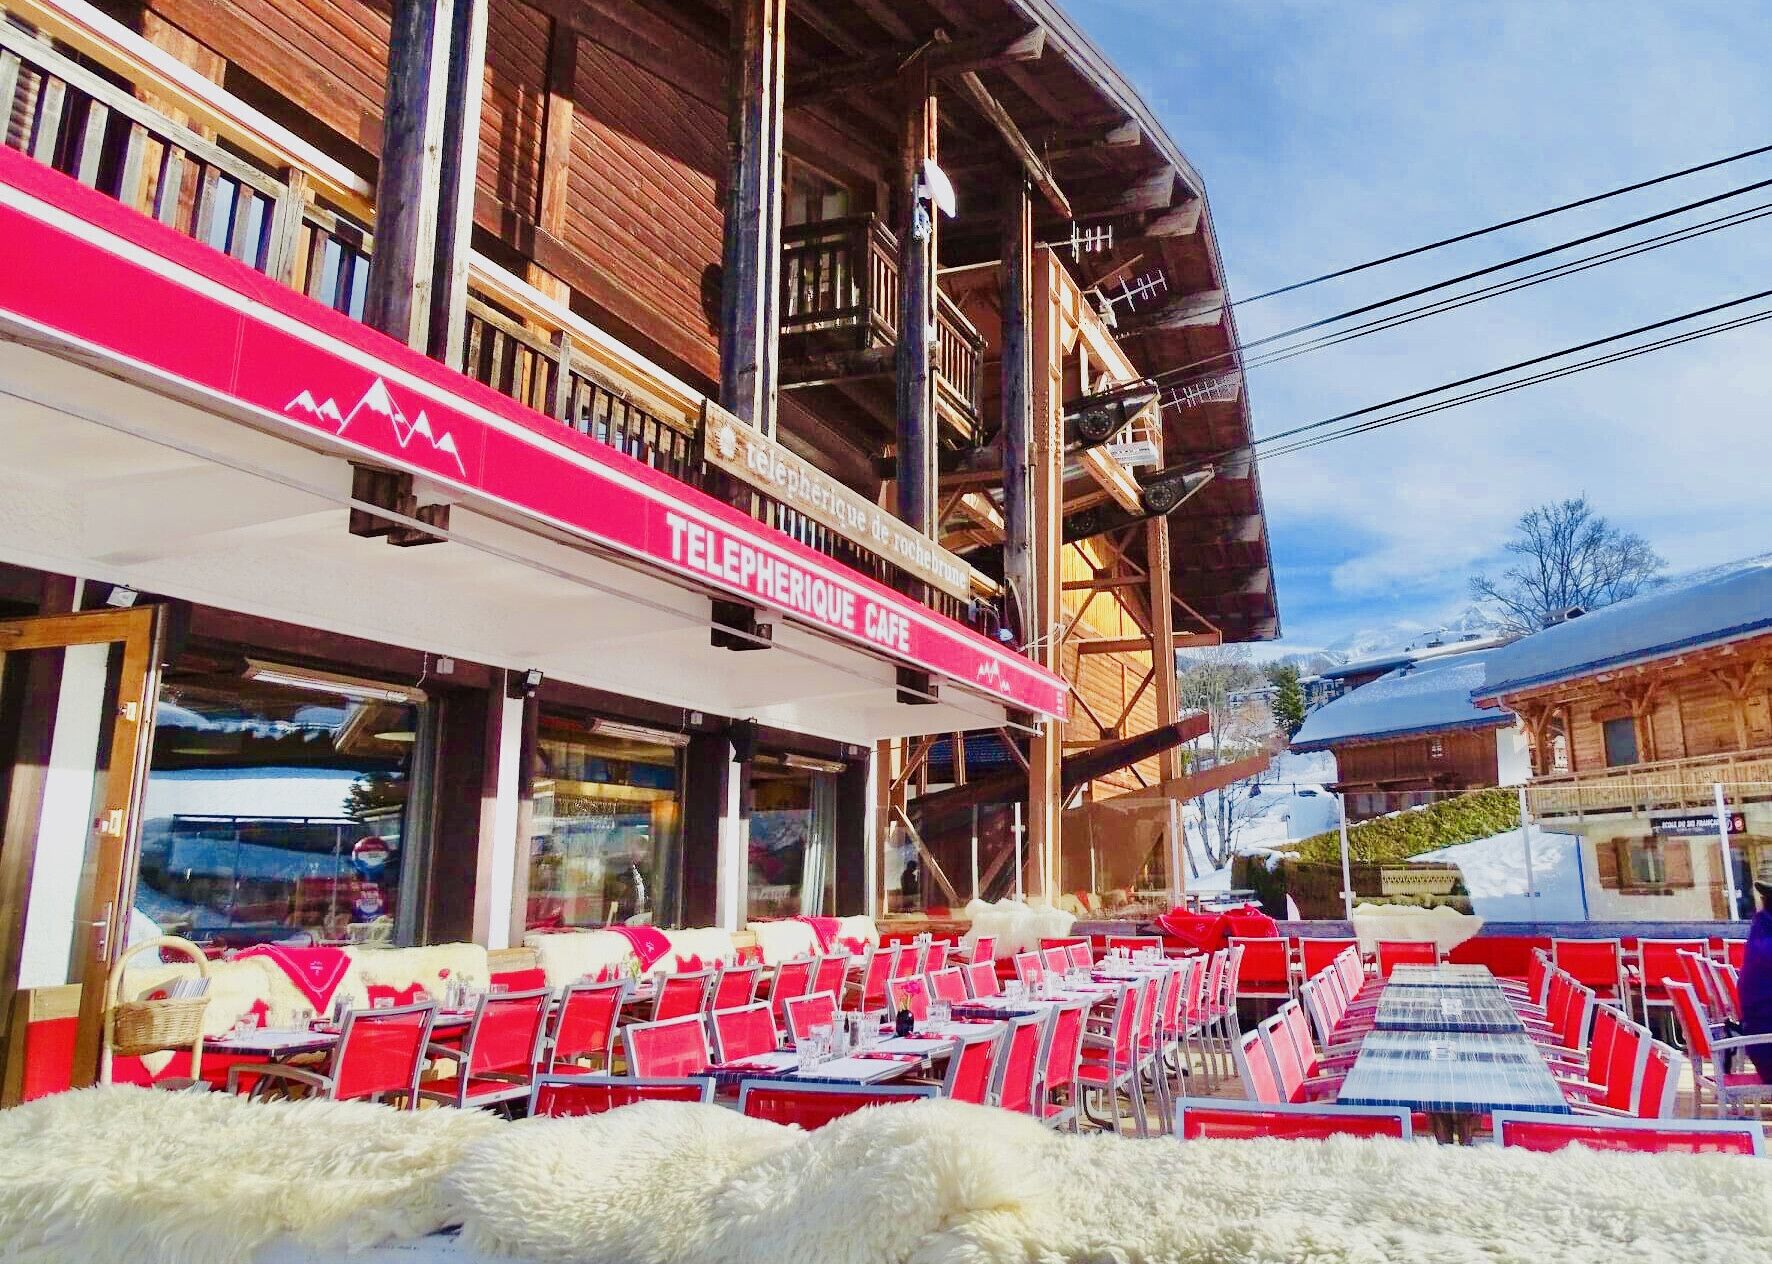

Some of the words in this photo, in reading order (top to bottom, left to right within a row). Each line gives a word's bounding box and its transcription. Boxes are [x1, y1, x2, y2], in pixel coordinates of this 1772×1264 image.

[666, 511, 856, 630] TELEPHERIQUE
[864, 602, 910, 652] CAFE
[871, 515, 889, 545] de
[894, 534, 967, 589] rochebrune
